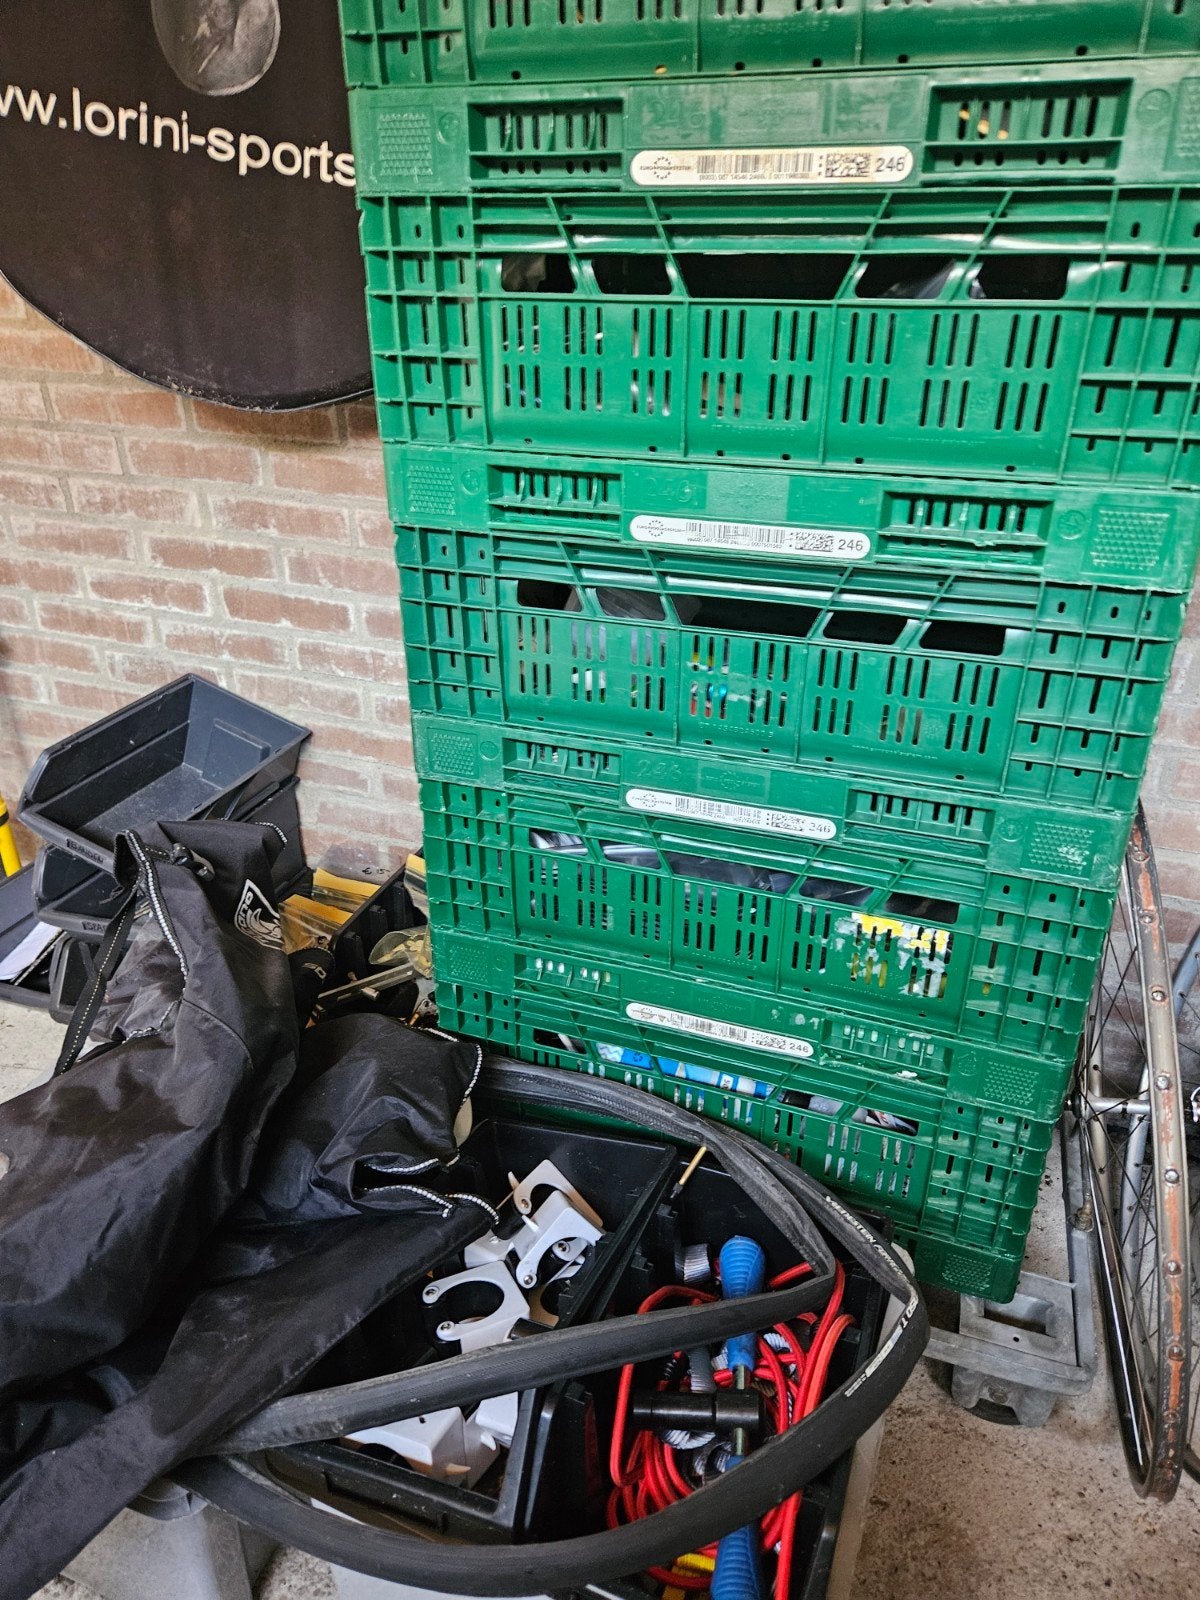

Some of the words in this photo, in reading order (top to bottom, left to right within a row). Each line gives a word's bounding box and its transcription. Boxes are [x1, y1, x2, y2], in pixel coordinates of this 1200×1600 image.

[875, 156, 906, 172] 246
[838, 538, 863, 551] 246
[789, 1042, 809, 1053] 246
